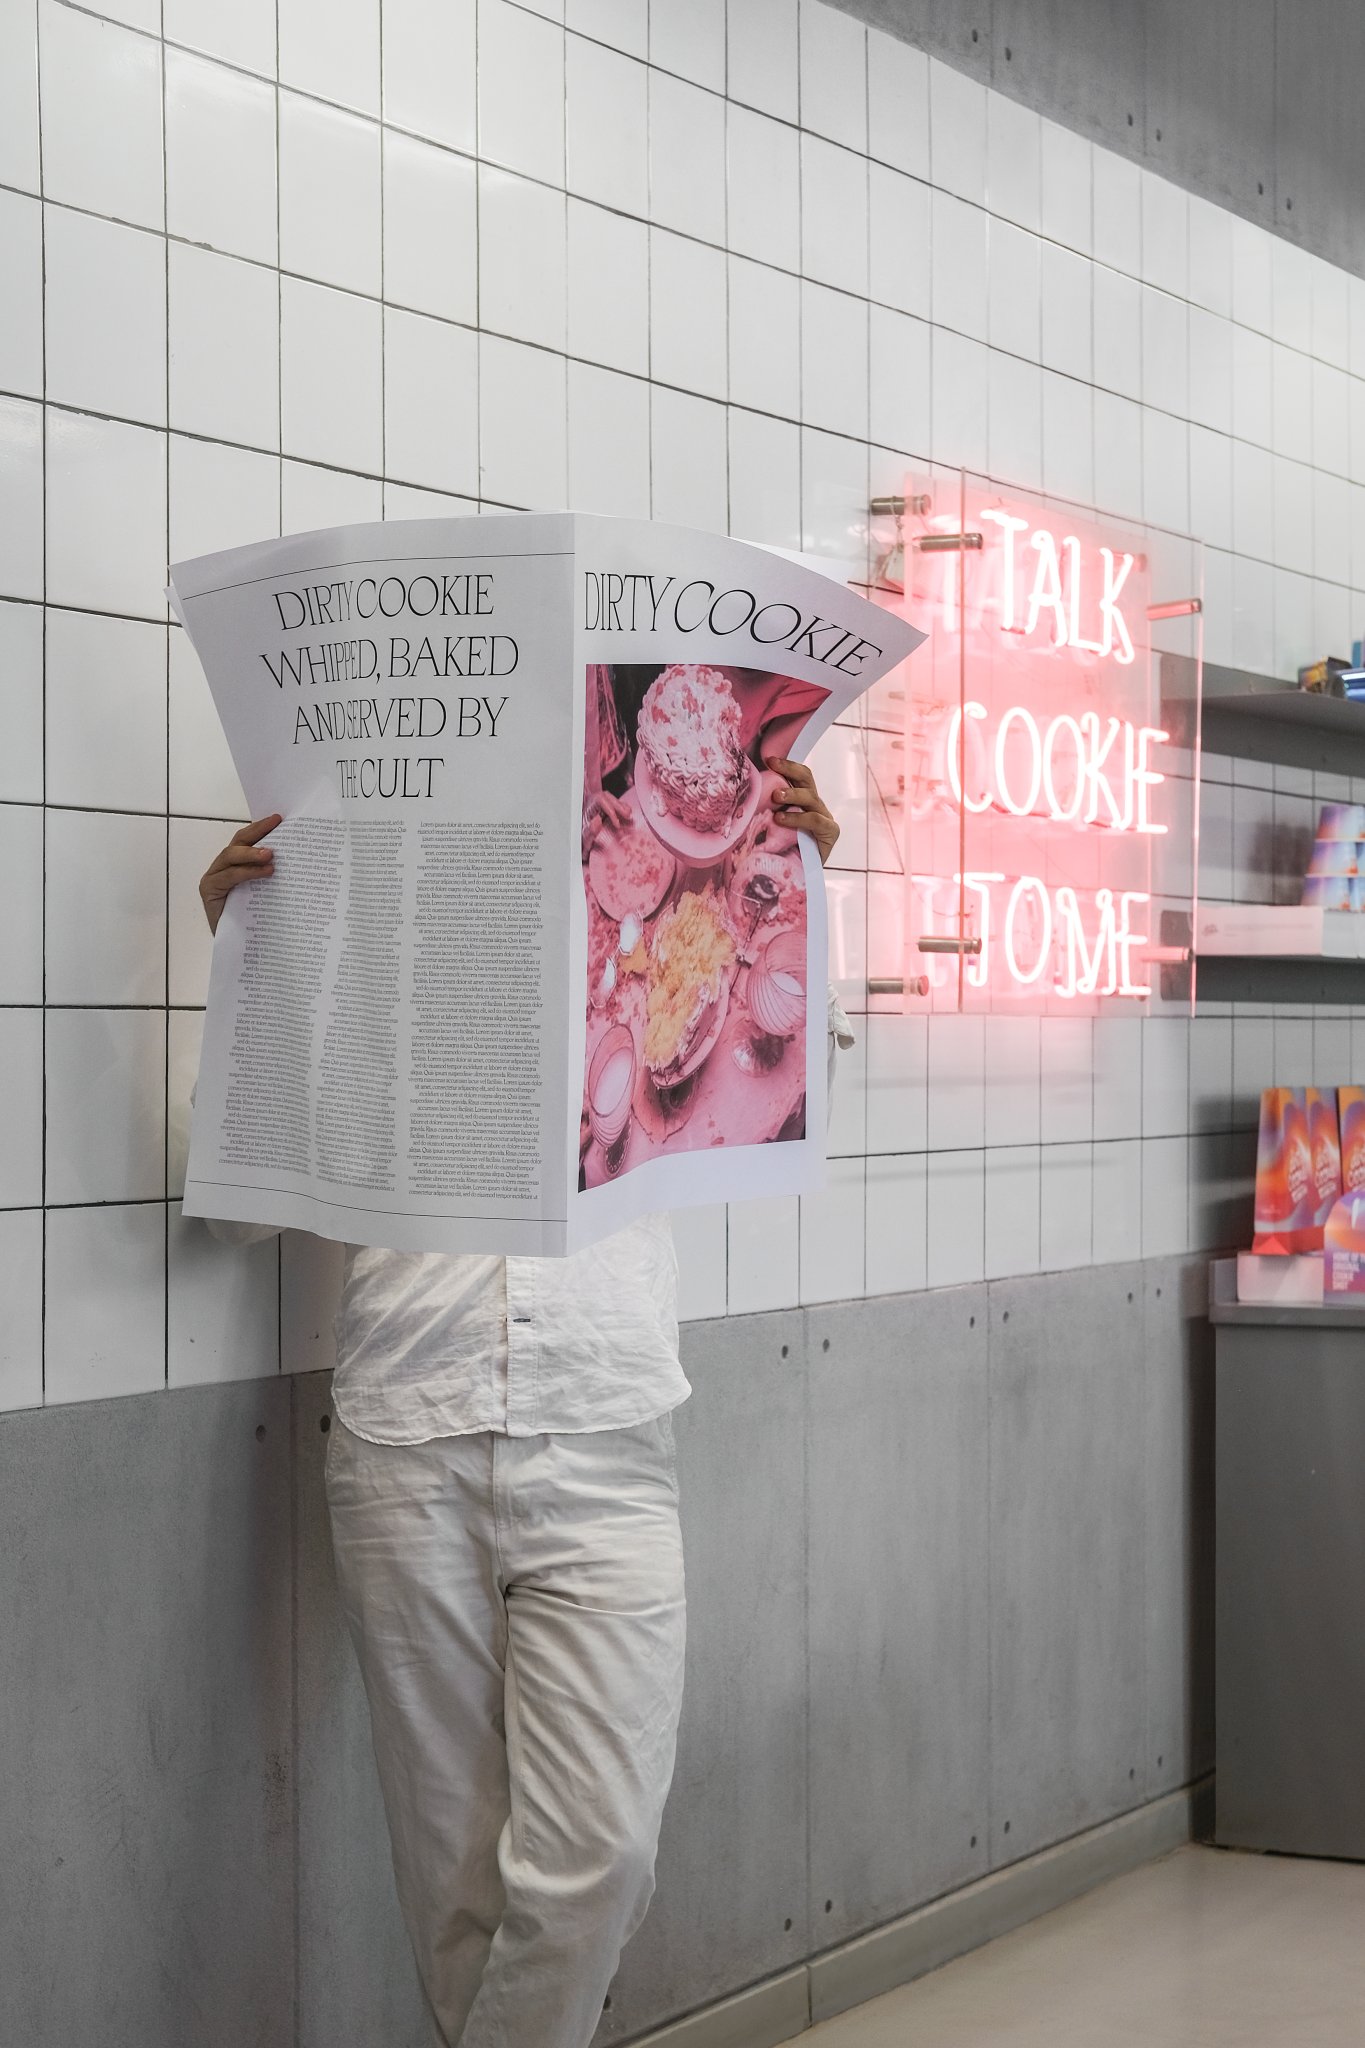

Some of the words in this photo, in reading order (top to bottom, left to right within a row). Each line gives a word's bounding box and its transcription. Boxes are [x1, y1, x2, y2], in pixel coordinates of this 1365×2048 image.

[272, 581, 355, 631] DIRTY
[356, 575, 495, 618] COOKIE
[980, 509, 1134, 665] TALK
[585, 572, 677, 632] DIRTY
[674, 581, 883, 677] COOKIE
[259, 639, 381, 689] WHIPPED,
[388, 636, 519, 678] BAKED
[293, 702, 346, 745] AND
[347, 698, 447, 740] SERVED
[456, 697, 510, 738] BY
[336, 760, 359, 799] THE
[360, 758, 445, 799] CULT
[947, 701, 1170, 834] COOKIE
